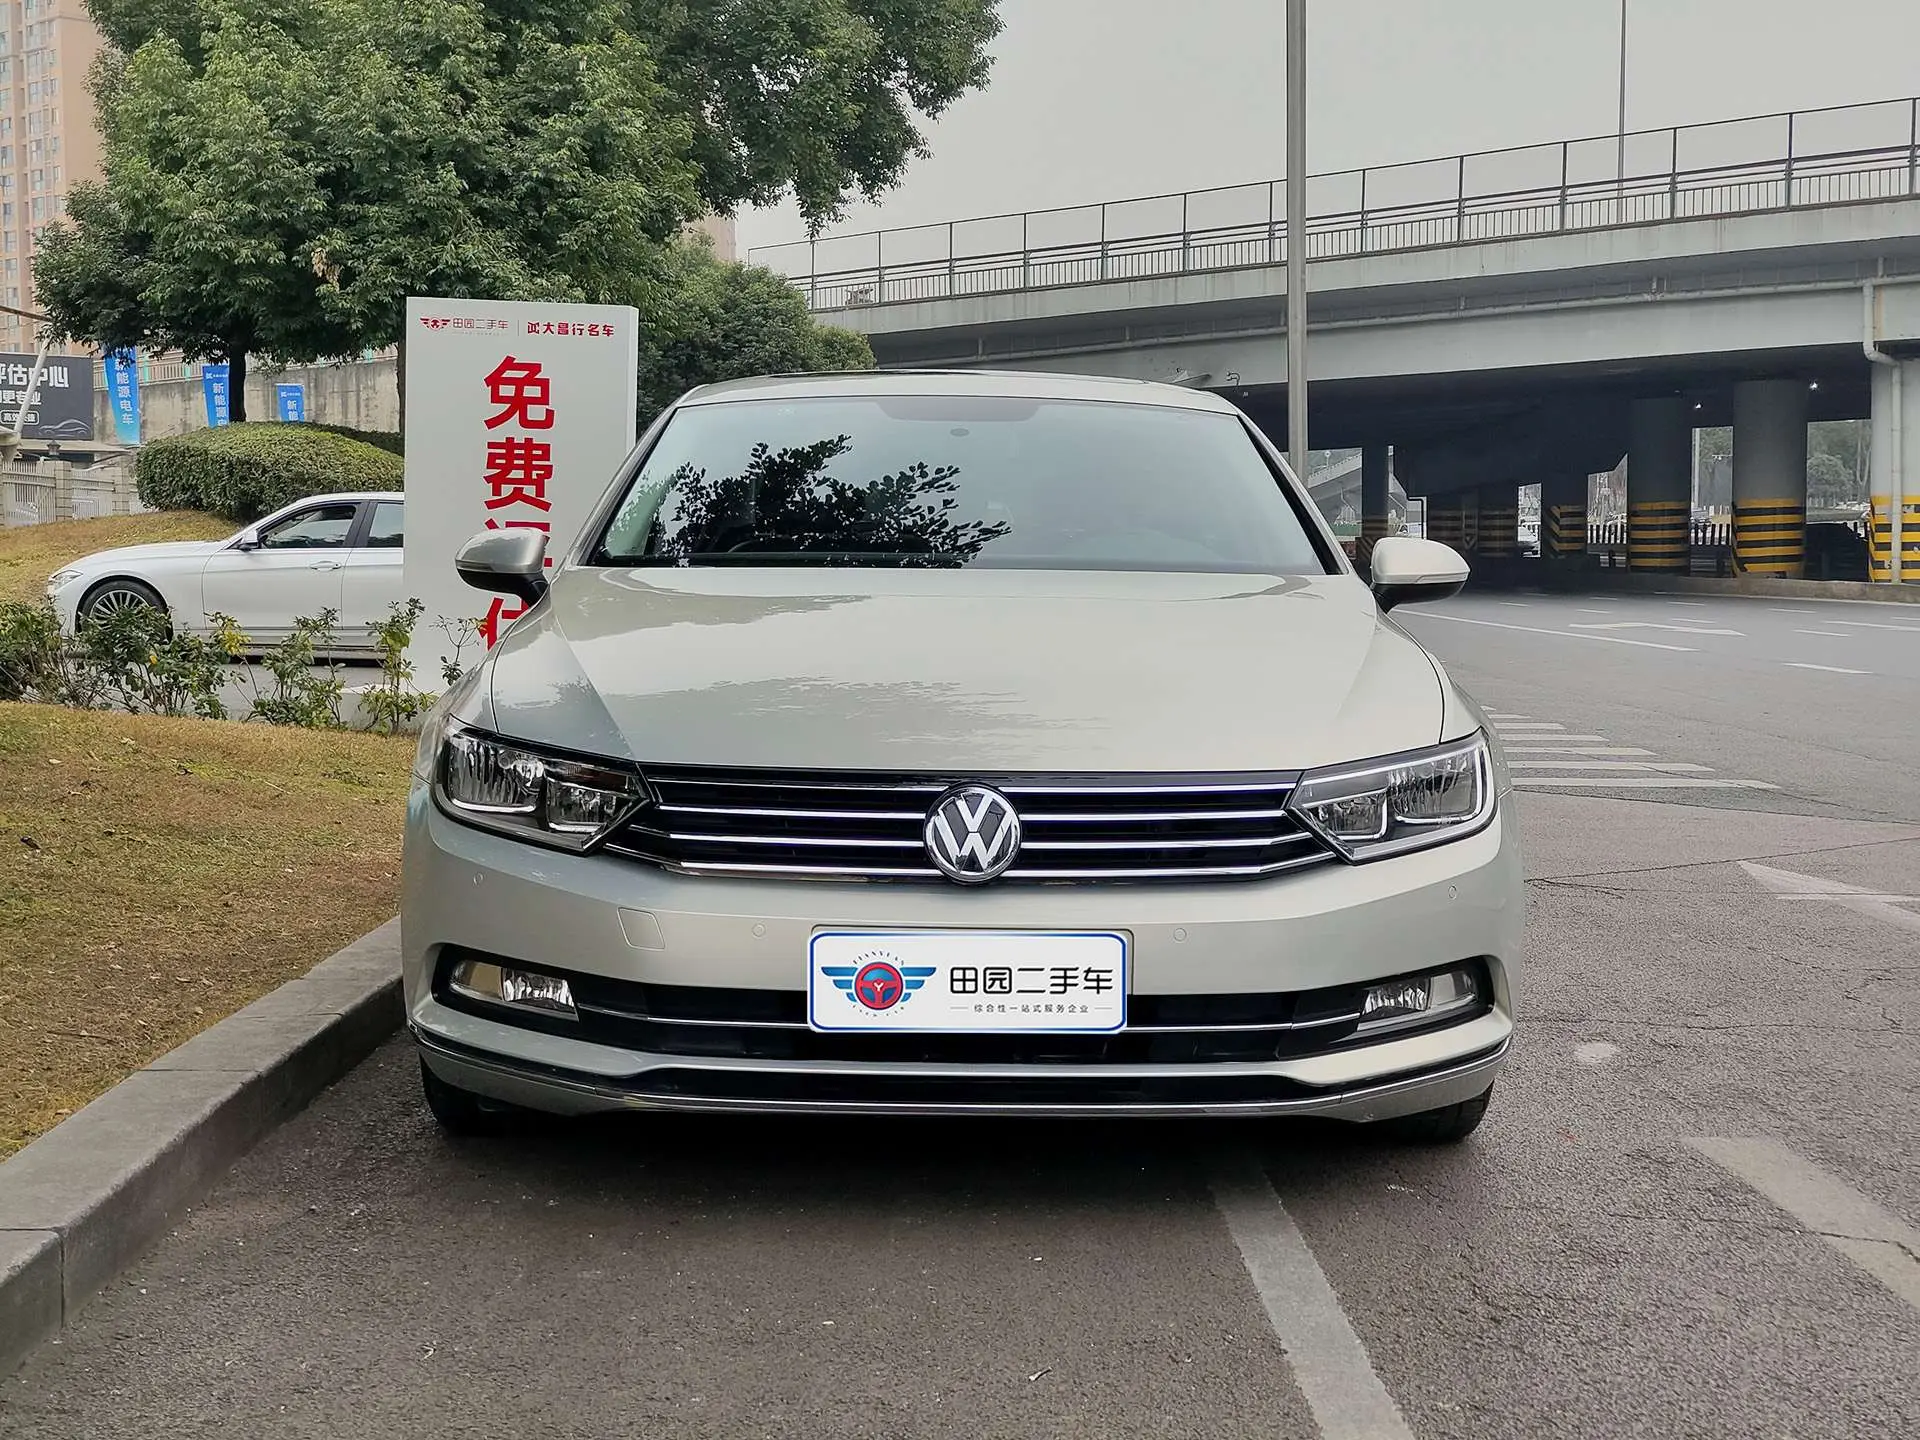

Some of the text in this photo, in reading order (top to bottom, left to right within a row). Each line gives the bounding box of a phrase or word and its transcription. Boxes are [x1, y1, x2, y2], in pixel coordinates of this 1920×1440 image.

[452, 317, 509, 331] 田园二手车
[542, 321, 615, 337] 大昌行名车
[950, 966, 1113, 995] 田园二手车
[974, 1003, 1089, 1014] 综合性一站式服务企业
